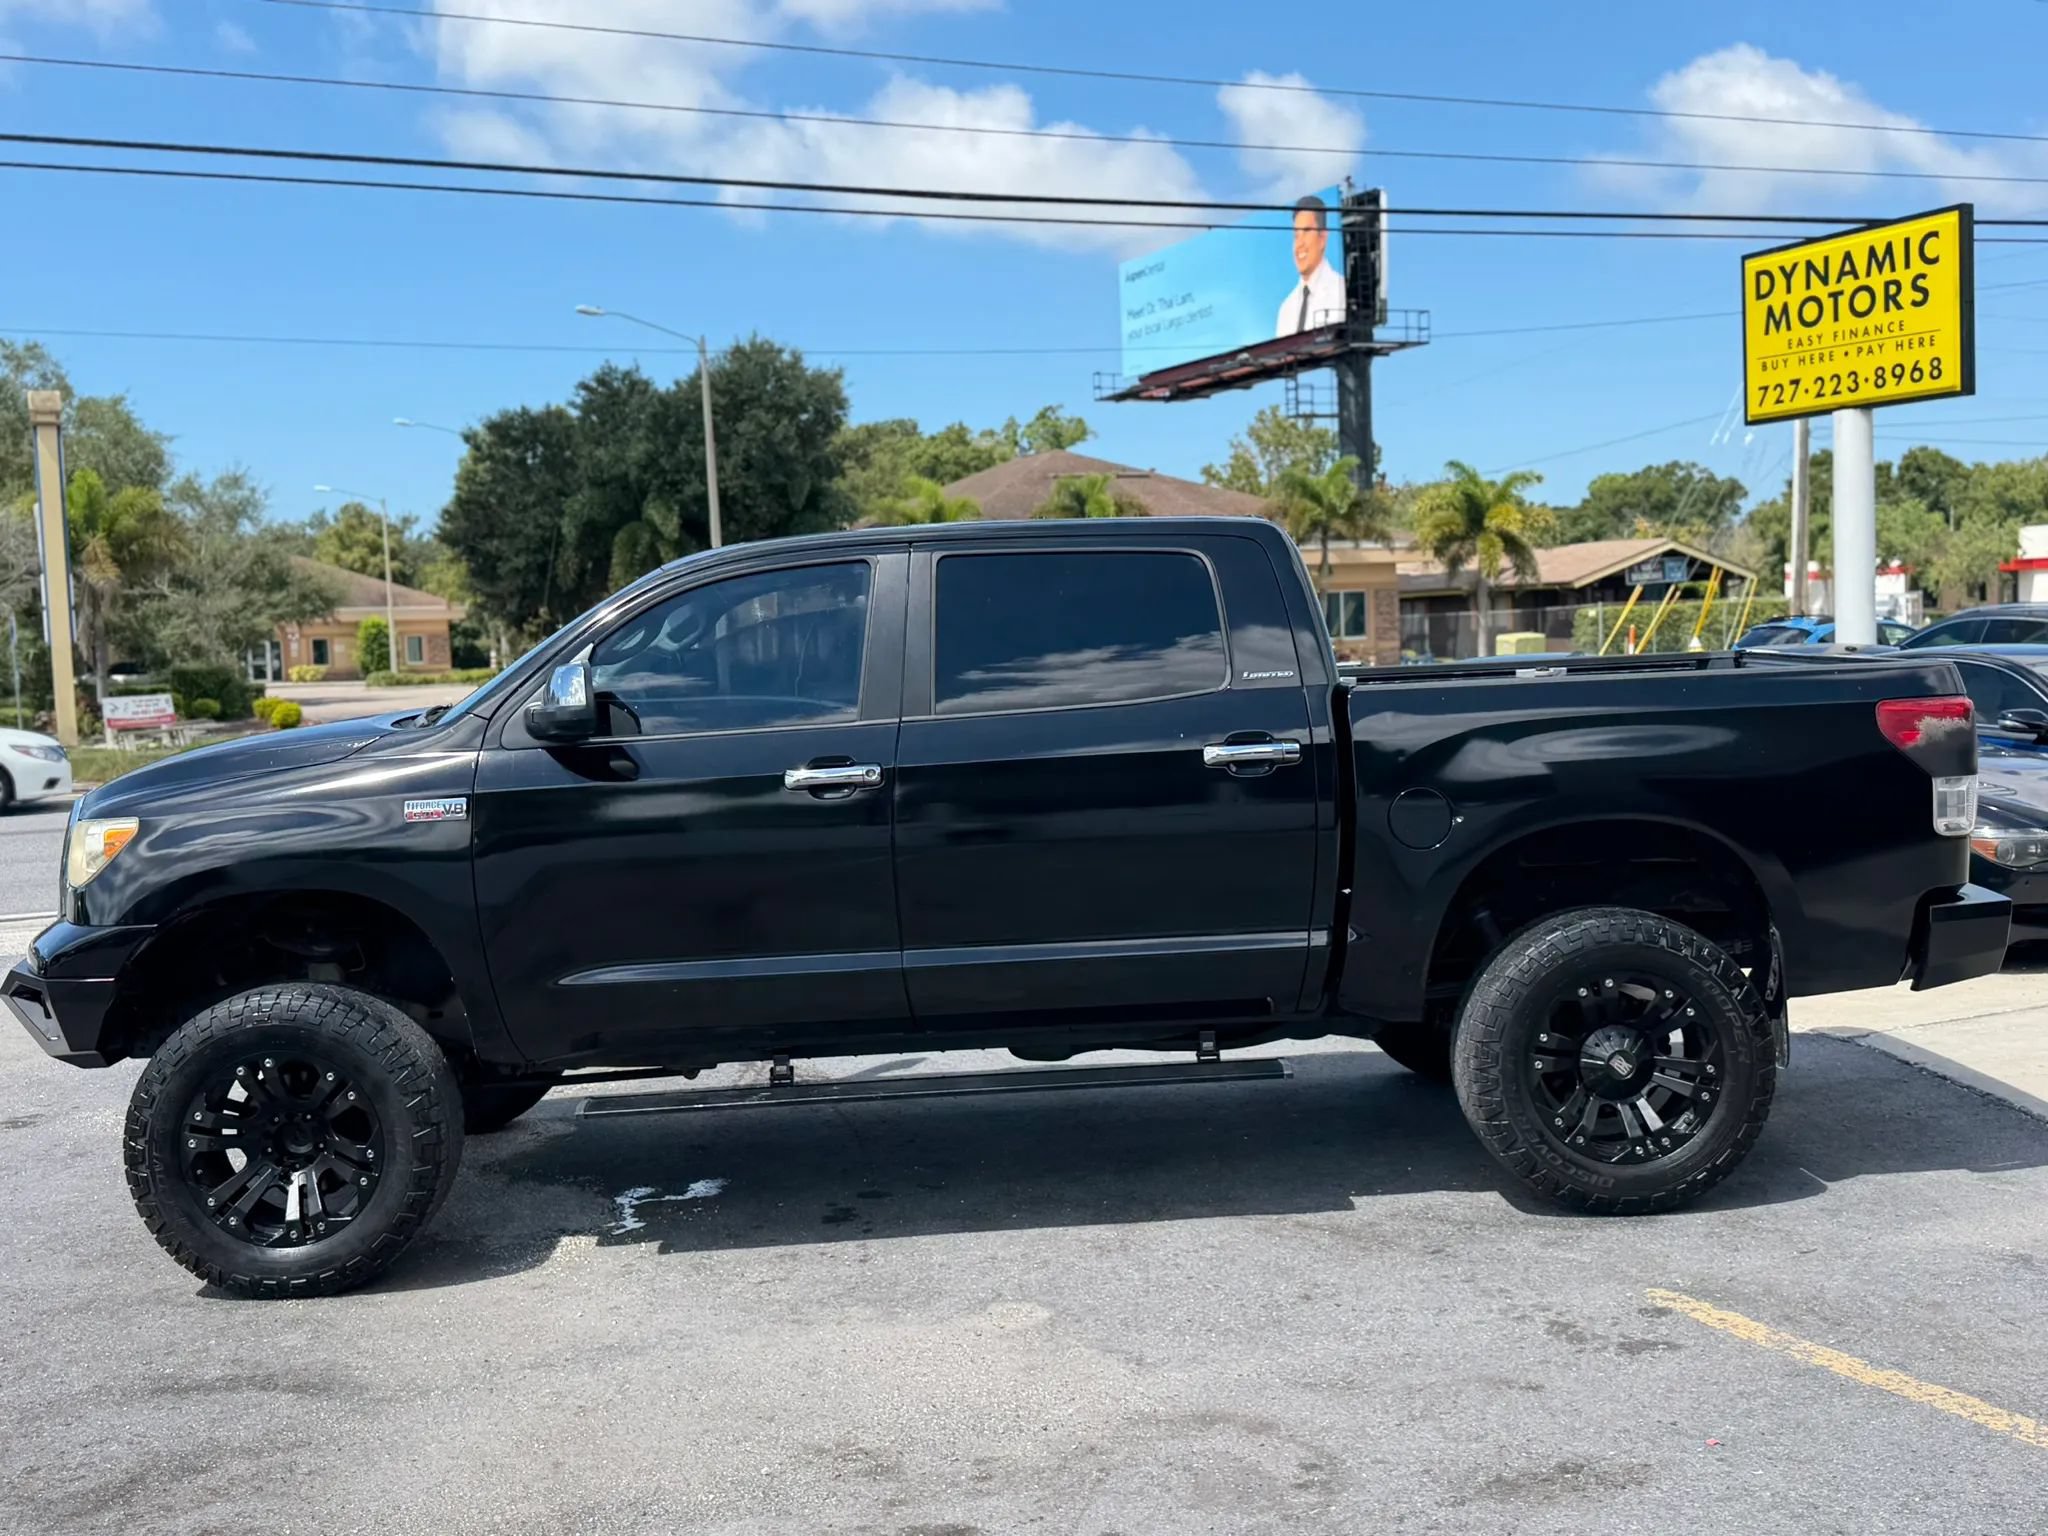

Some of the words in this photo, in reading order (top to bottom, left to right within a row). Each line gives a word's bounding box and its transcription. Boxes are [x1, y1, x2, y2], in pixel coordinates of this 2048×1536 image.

[1755, 230, 1940, 301] DYNAMIC
[1764, 273, 1930, 336] MOTORS
[1761, 357, 1790, 372] BUY
[1798, 350, 1835, 367] HERE
[1856, 343, 1885, 357] PAY
[1896, 335, 1936, 352] HERE
[1787, 333, 1824, 350] EASY
[1833, 320, 1905, 342] FINANCE
